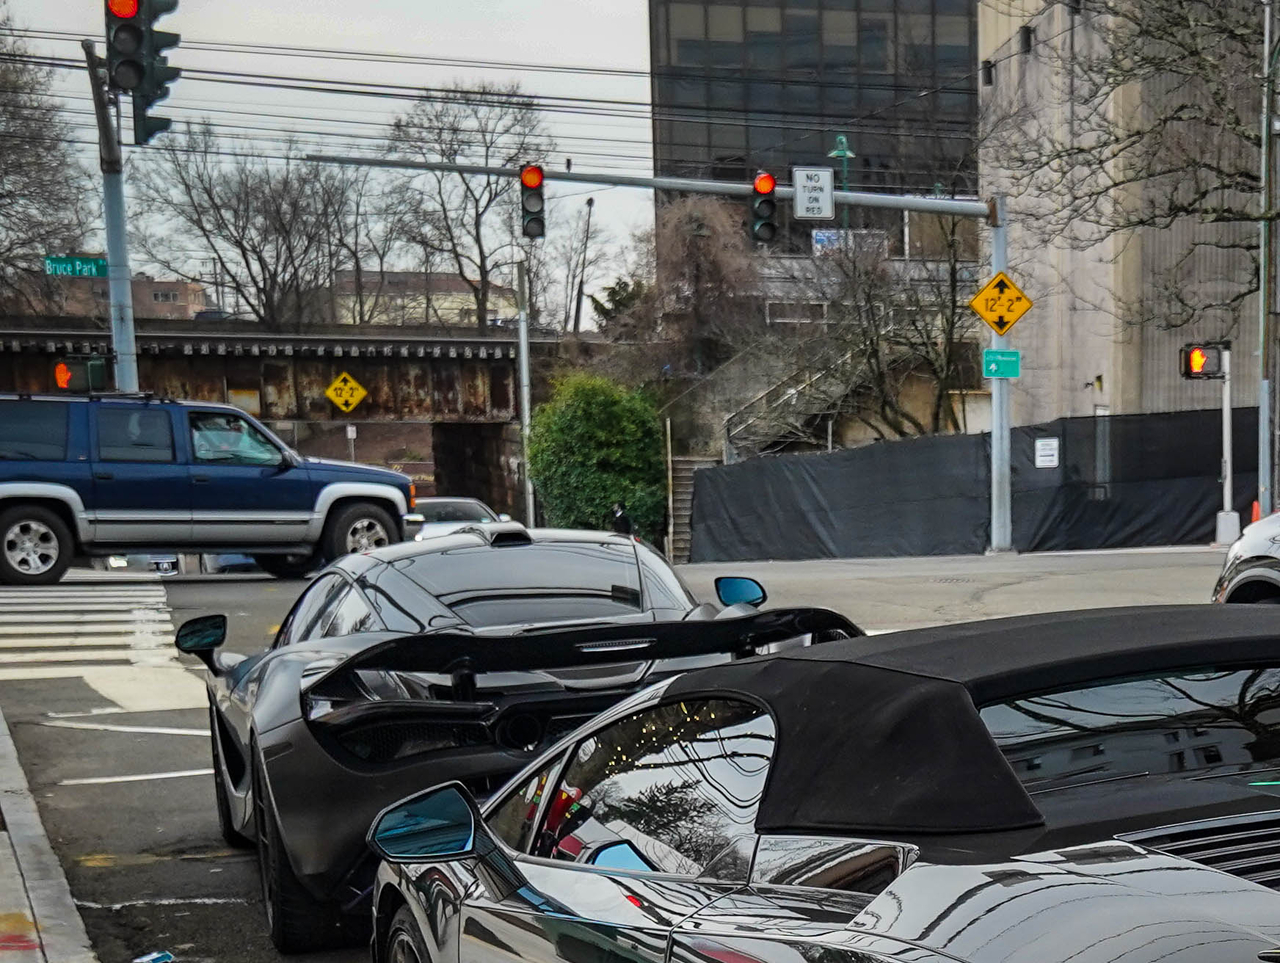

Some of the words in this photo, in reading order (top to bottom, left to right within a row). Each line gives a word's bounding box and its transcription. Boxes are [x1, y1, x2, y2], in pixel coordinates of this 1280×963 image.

[806, 173, 820, 183] NO
[802, 185, 825, 194] TURN
[808, 196, 820, 204] ON
[805, 206, 823, 215] RED
[45, 259, 73, 276] Bruce
[75, 260, 98, 276] Park
